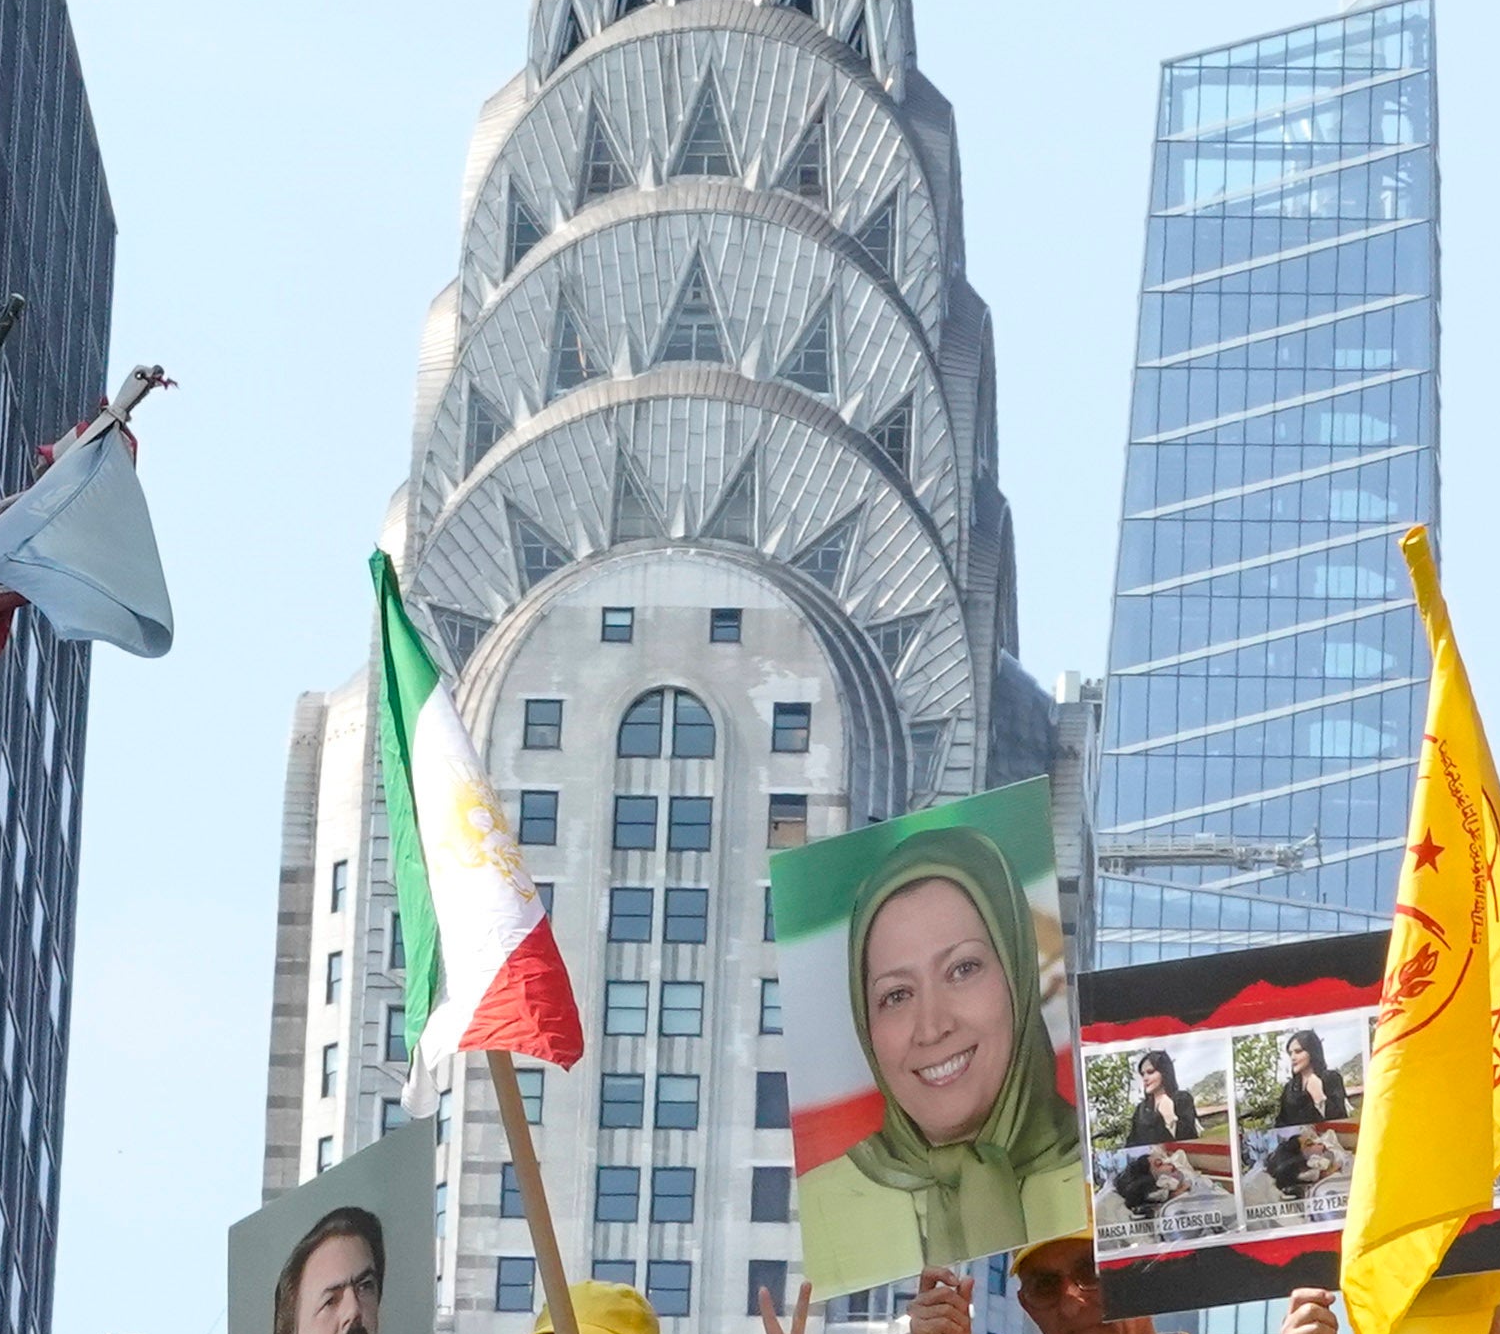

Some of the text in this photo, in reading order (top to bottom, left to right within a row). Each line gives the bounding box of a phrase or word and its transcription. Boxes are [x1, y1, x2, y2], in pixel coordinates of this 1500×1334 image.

[1313, 1199, 1325, 1212] 22
[1326, 1195, 1348, 1210] YEAR
[1162, 1218, 1173, 1232] 22
[1174, 1214, 1203, 1231] YEARS
[1204, 1212, 1222, 1226] OLD
